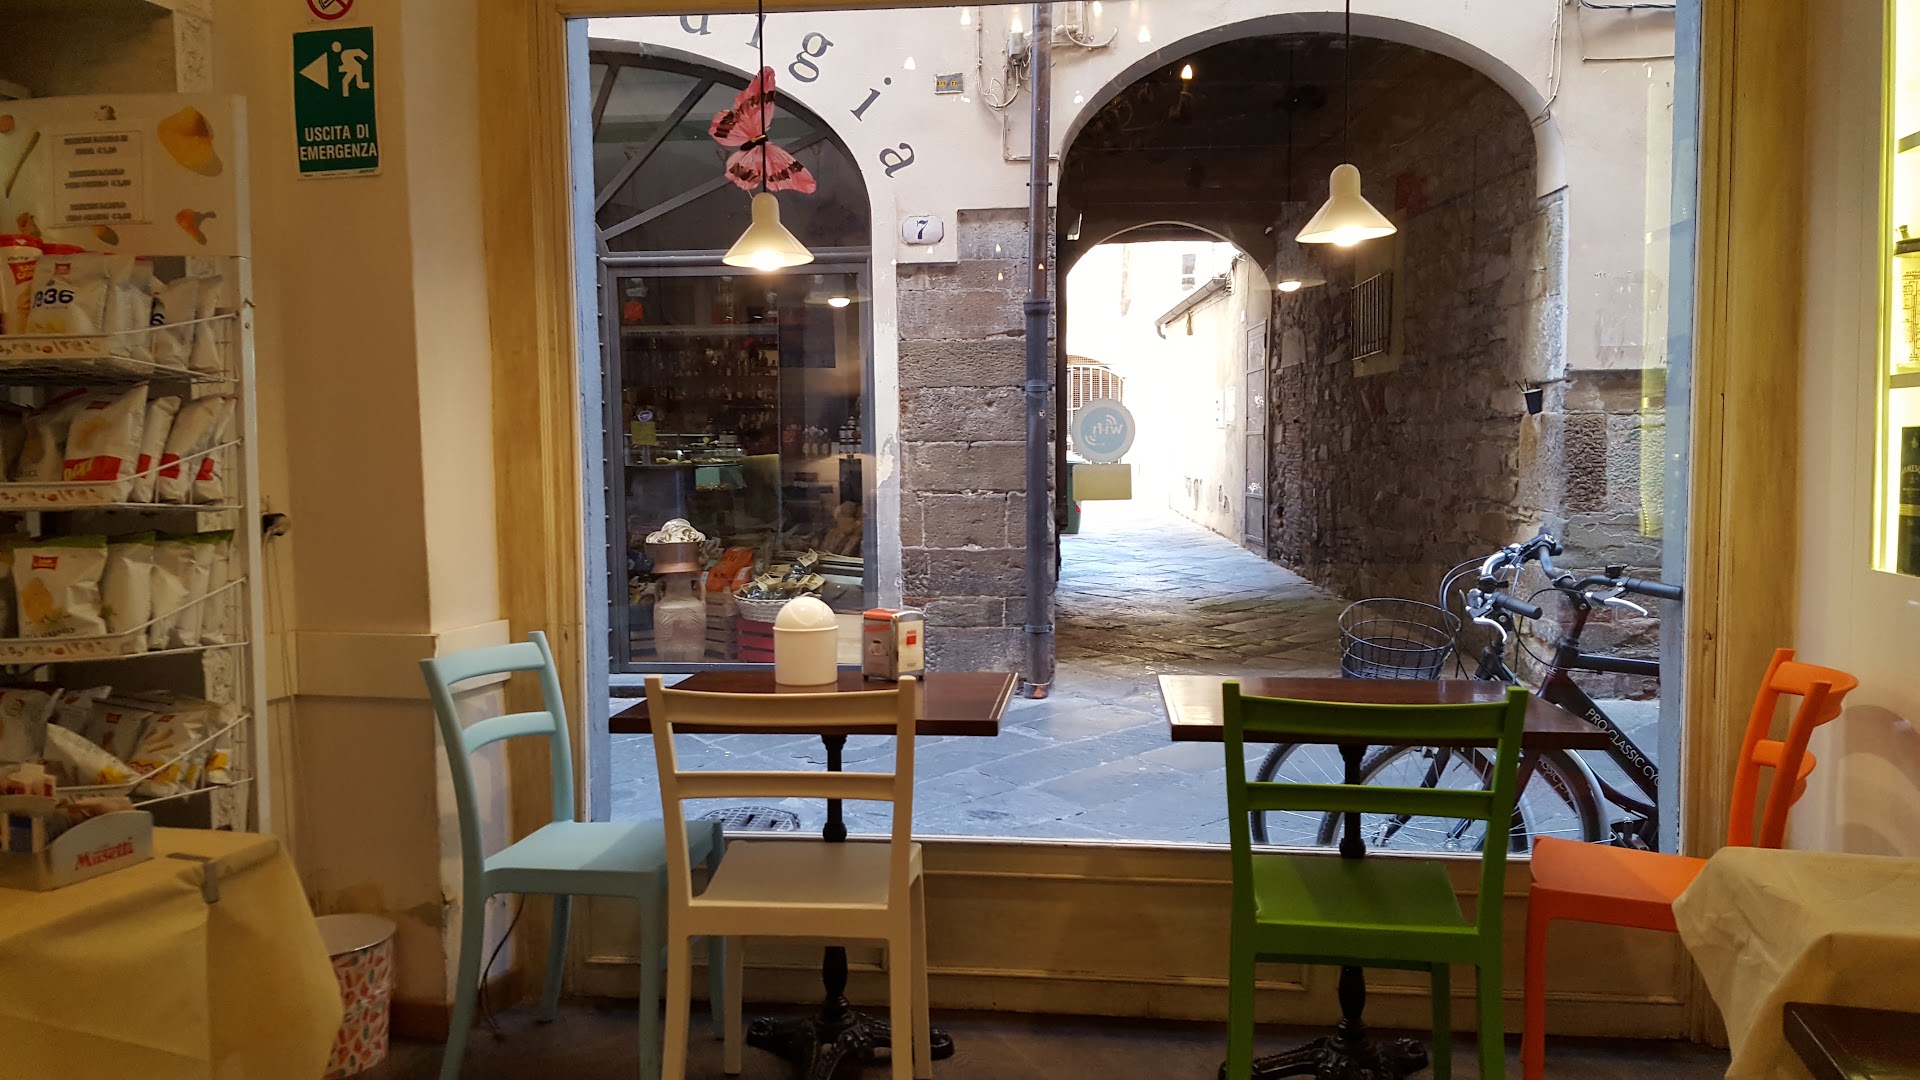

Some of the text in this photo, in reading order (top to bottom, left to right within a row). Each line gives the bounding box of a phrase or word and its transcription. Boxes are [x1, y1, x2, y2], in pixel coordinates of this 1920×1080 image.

[304, 124, 369, 142] USCITA DI
[300, 142, 378, 161] EMERGENZA
[916, 219, 928, 240] 7
[1585, 708, 1608, 732] PRO
[1607, 729, 1645, 768] CLASSIC
